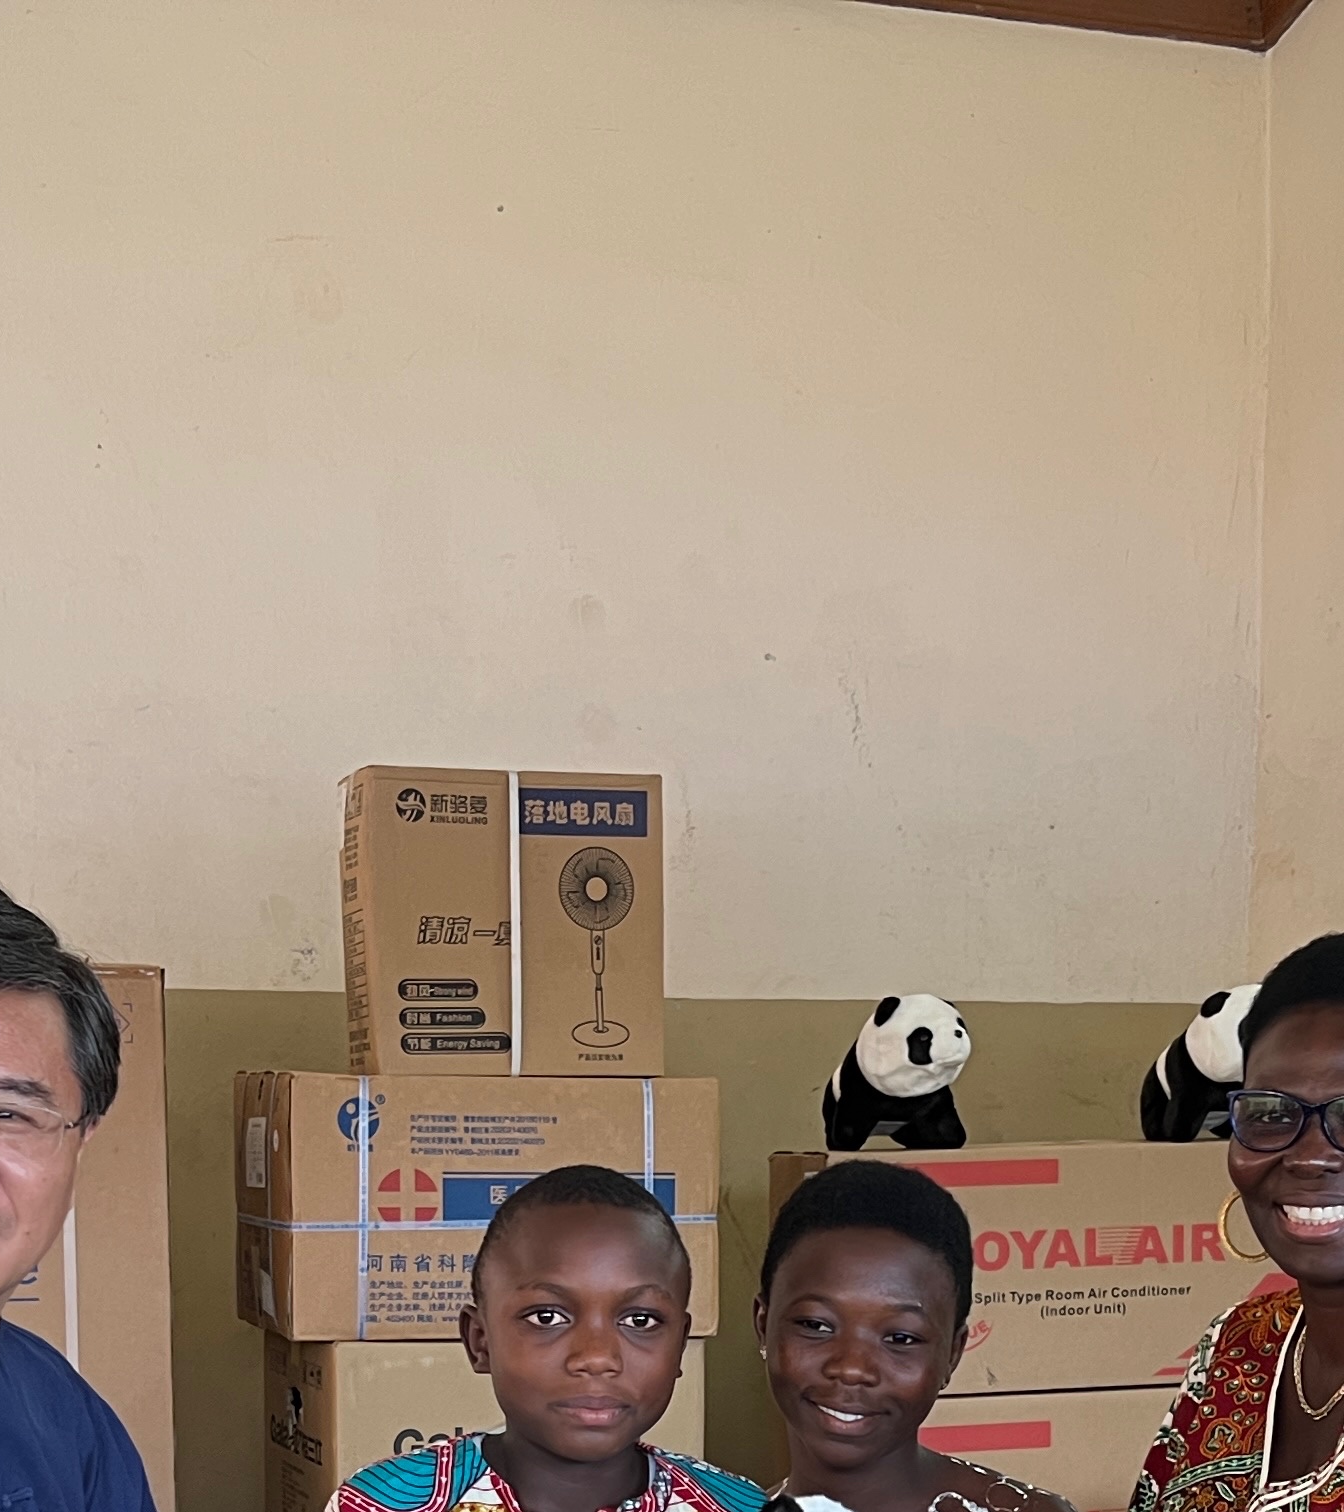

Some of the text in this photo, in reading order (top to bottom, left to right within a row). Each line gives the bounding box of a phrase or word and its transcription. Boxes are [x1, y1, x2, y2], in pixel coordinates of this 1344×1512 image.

[524, 800, 635, 827] 落地电风扇
[436, 1013, 473, 1023] Fashion
[436, 1039, 469, 1050] Energy
[469, 1038, 501, 1050] Saving
[973, 1223, 1226, 1271] OYAL AIR
[974, 1285, 1192, 1305] Split Type Room Air Conditioner
[1040, 1302, 1127, 1319] (Indoor Unit)
